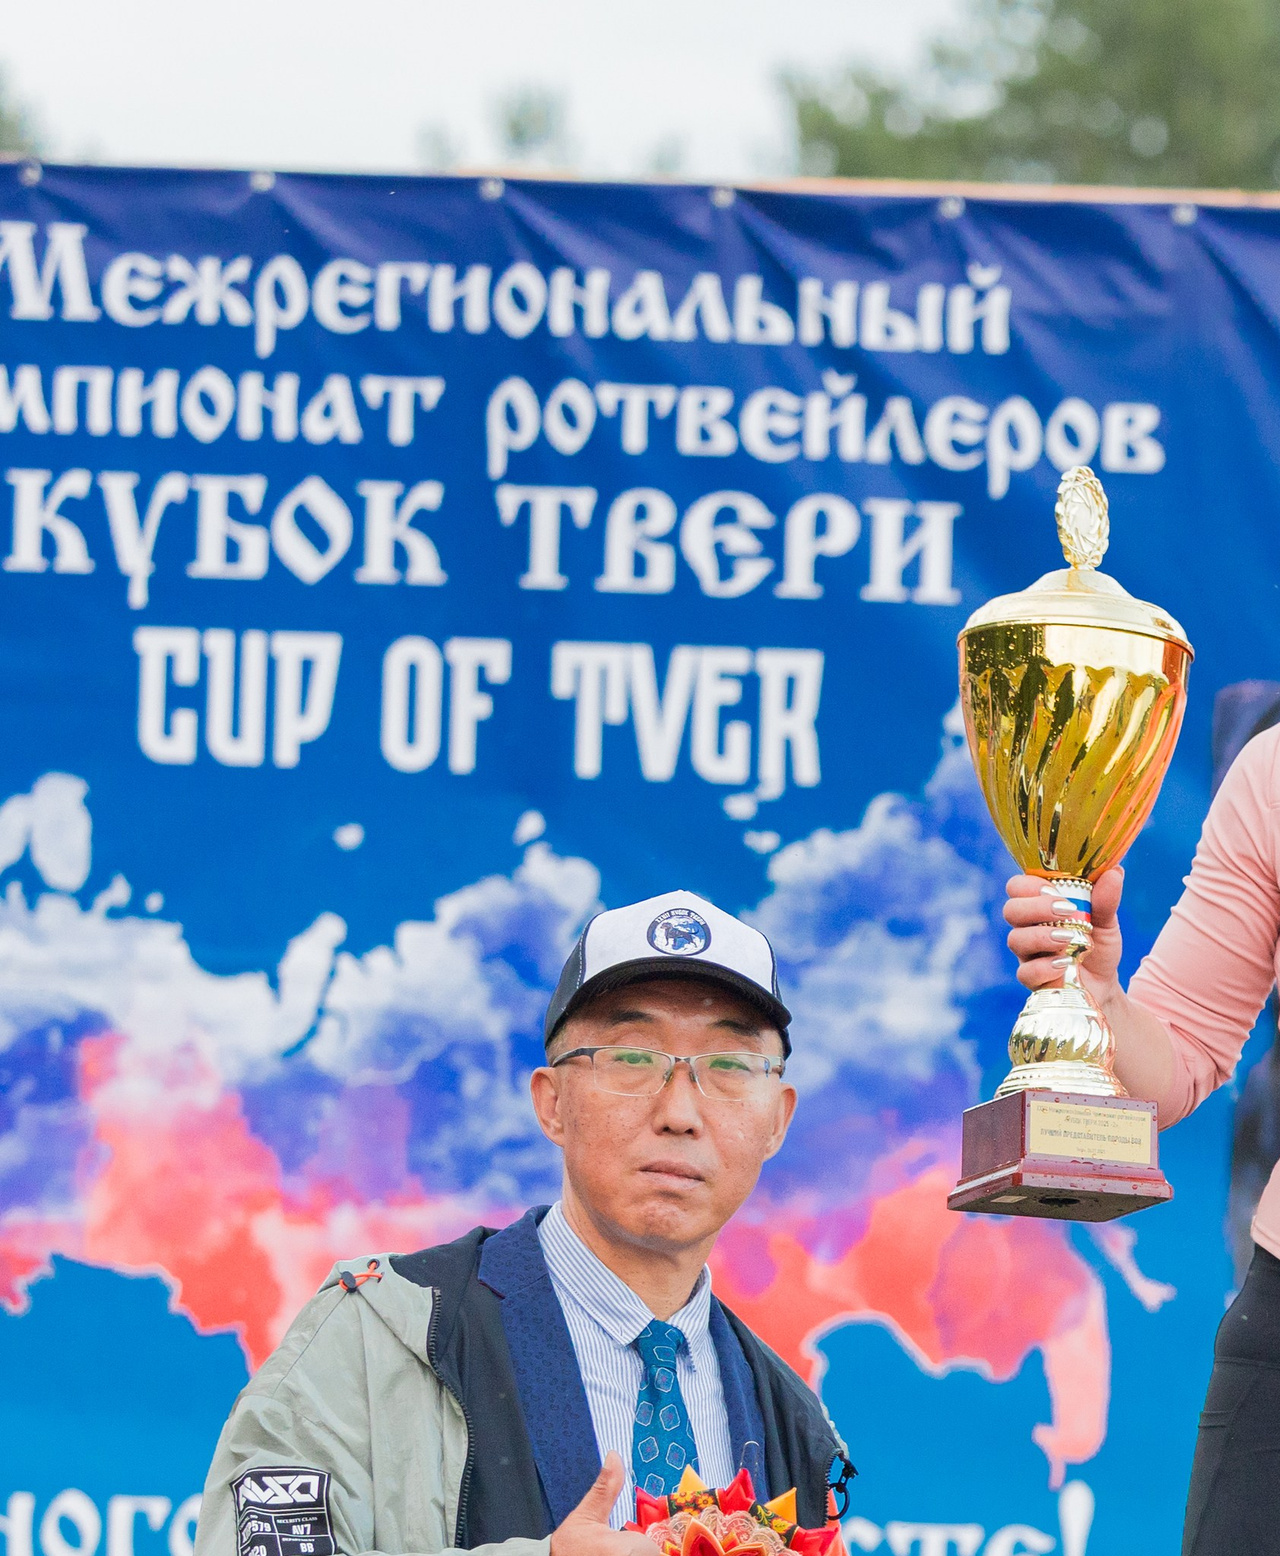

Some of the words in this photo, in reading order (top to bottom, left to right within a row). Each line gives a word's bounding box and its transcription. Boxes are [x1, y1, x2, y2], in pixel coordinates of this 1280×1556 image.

[0, 221, 1011, 358] Межрегиональный
[486, 369, 1165, 499] ротвейлеров
[3, 468, 447, 609] КУБОК
[495, 485, 962, 605] ТВЕРИ
[134, 625, 343, 769] CUP
[381, 635, 512, 774] OF
[551, 639, 823, 800] TVER
